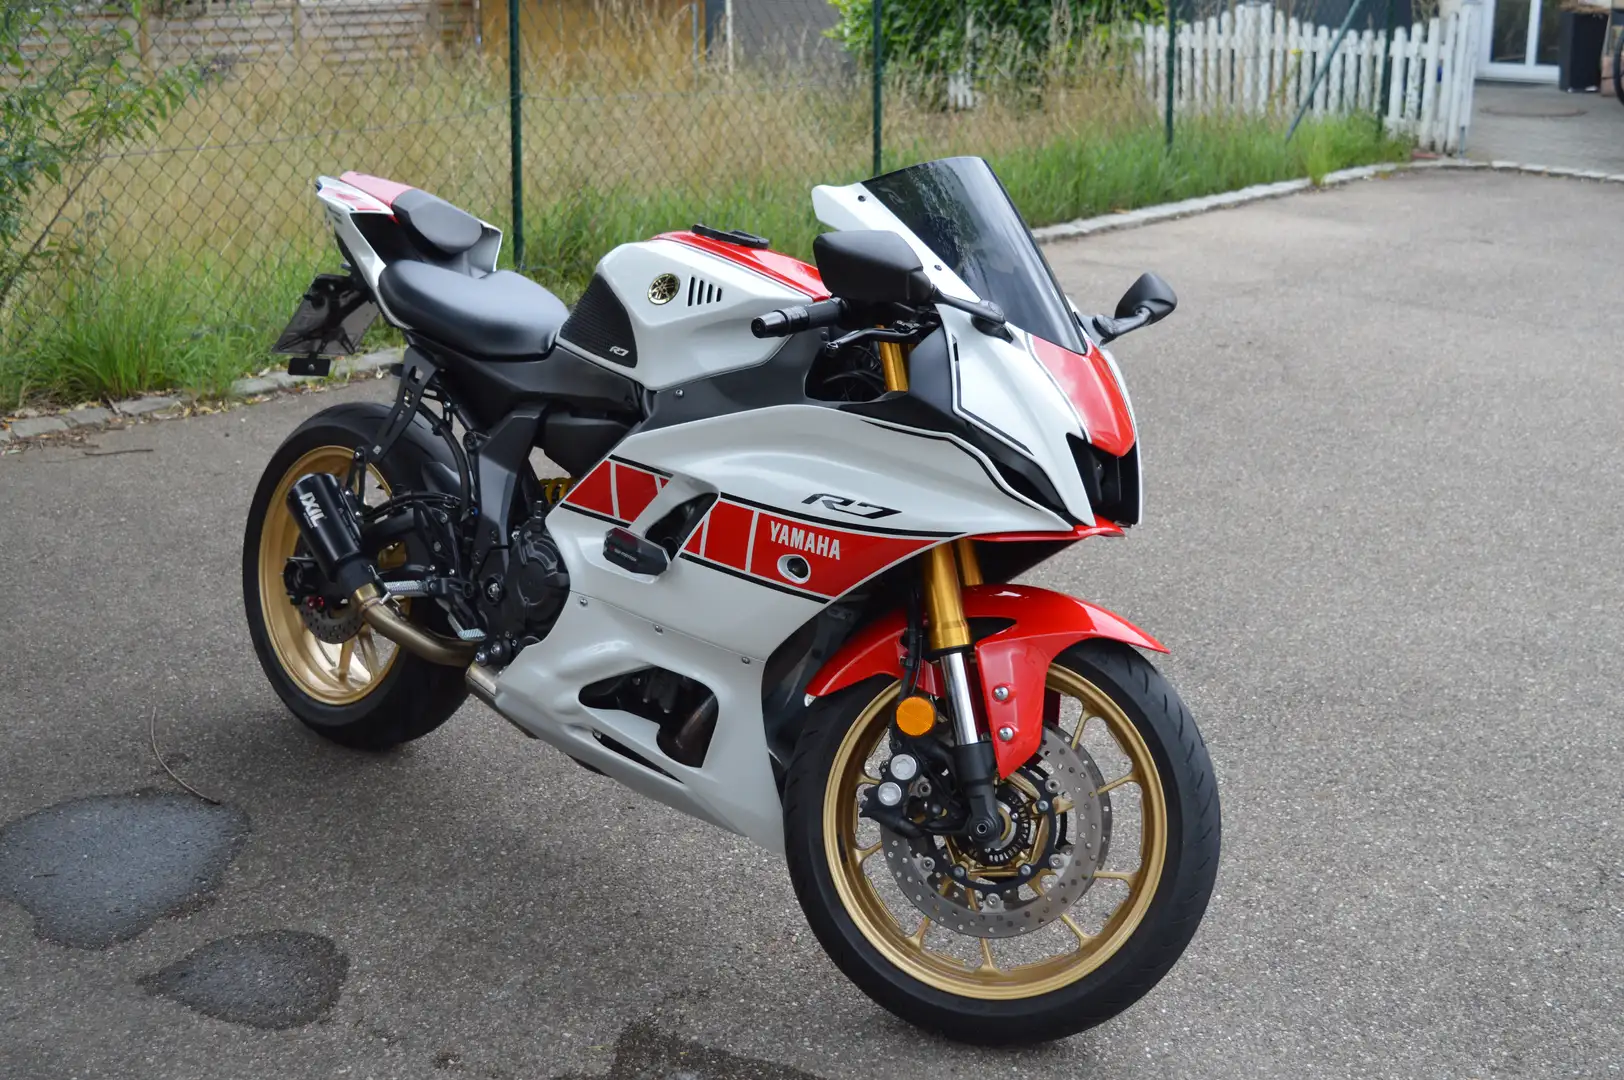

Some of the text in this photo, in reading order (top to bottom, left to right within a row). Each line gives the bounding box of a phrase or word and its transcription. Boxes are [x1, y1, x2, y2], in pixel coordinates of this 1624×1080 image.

[299, 492, 325, 527] IXIL
[801, 493, 902, 519] R7
[770, 520, 840, 560] YAMAHA
